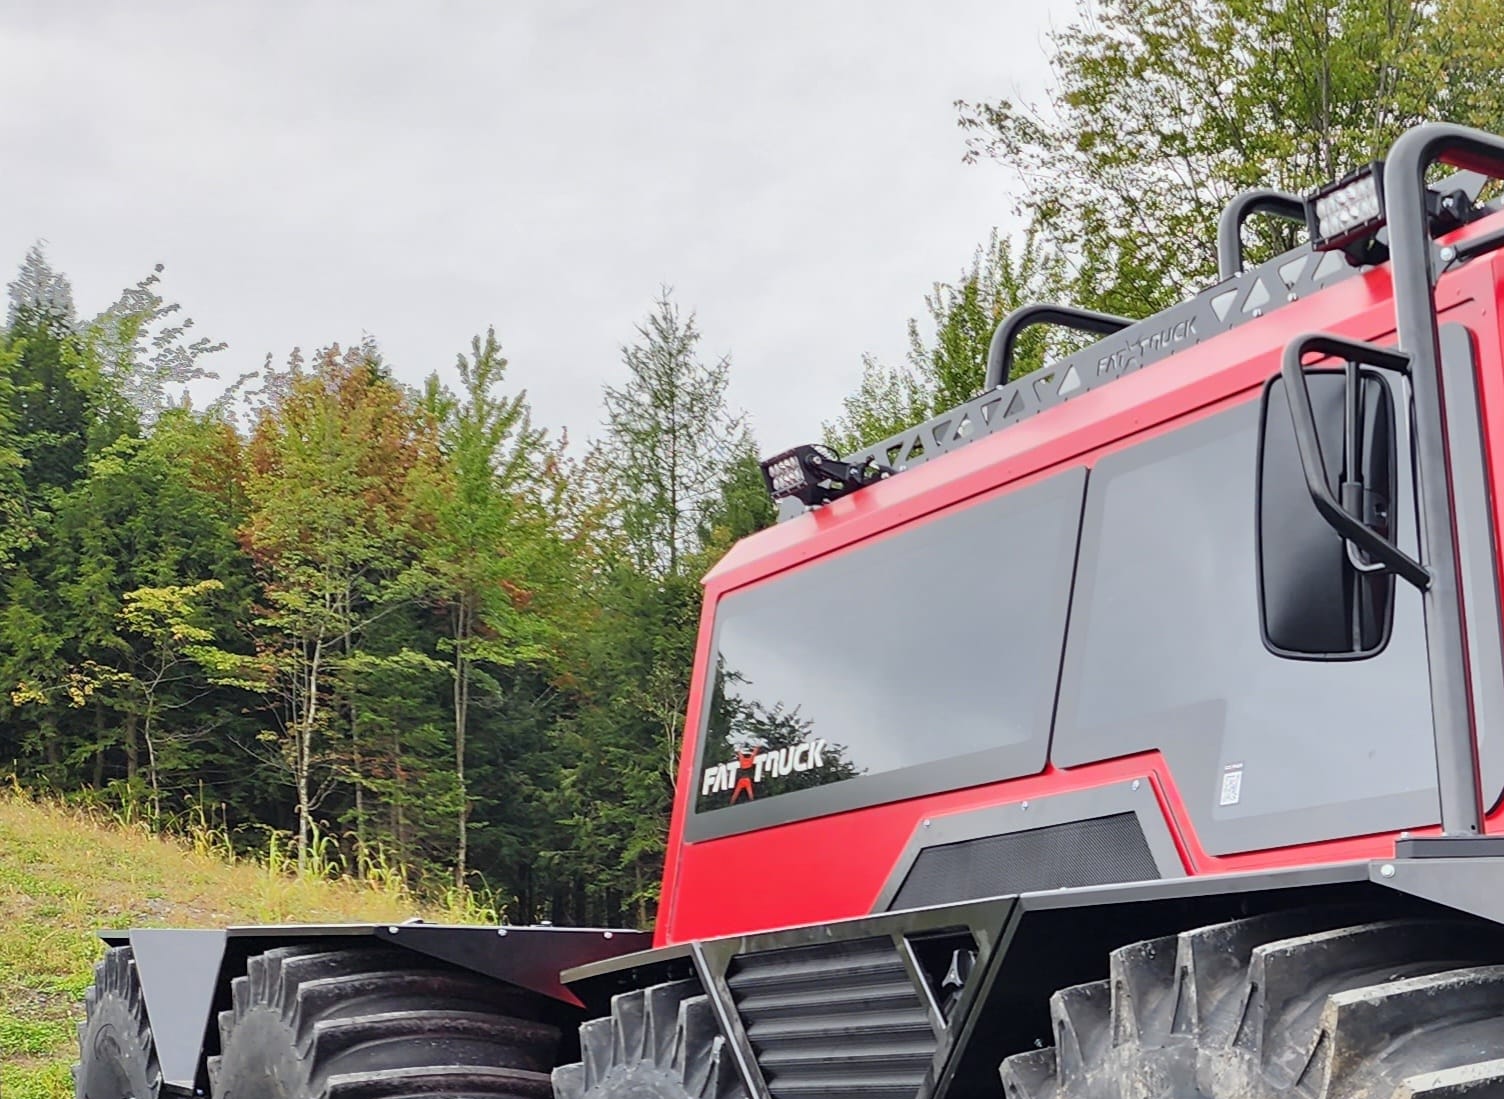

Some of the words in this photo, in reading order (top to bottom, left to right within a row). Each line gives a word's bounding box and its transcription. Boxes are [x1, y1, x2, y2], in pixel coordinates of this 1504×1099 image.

[1096, 348, 1127, 377] FAT
[1139, 315, 1197, 357] TRUCK
[702, 761, 741, 796] FAT
[753, 738, 826, 783] TRUCK
